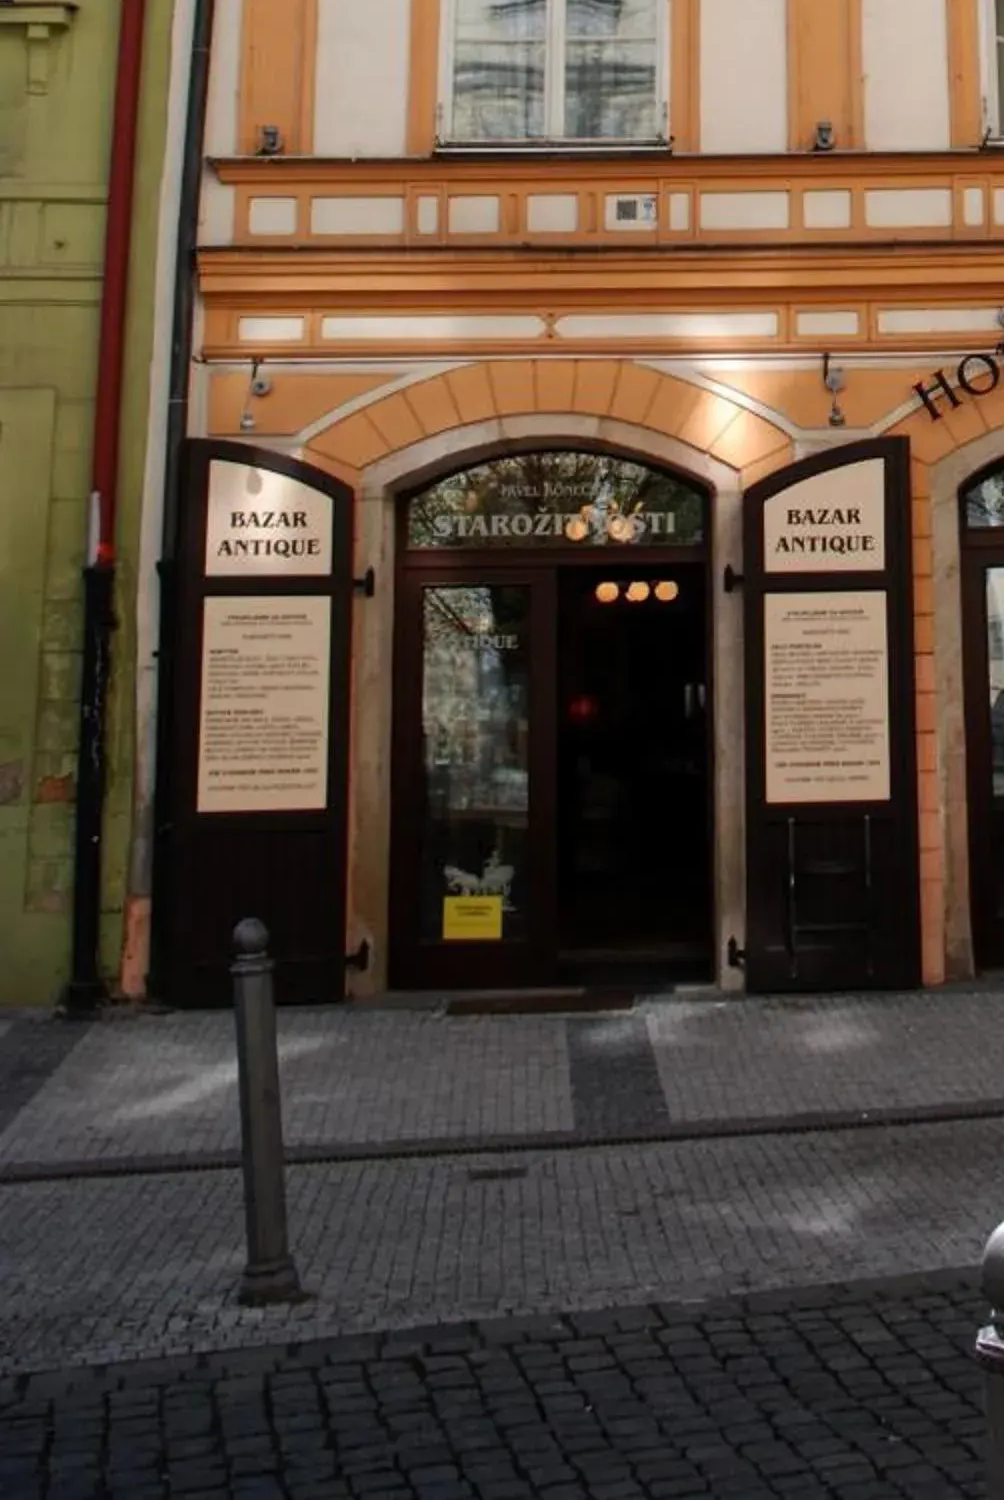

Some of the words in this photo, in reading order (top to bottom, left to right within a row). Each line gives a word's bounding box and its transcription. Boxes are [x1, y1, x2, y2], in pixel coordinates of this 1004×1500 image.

[230, 511, 308, 528] BAZAR
[786, 508, 861, 525] BAZAR
[217, 539, 321, 558] ANTIQUE
[775, 535, 875, 554] ANTIQUE
